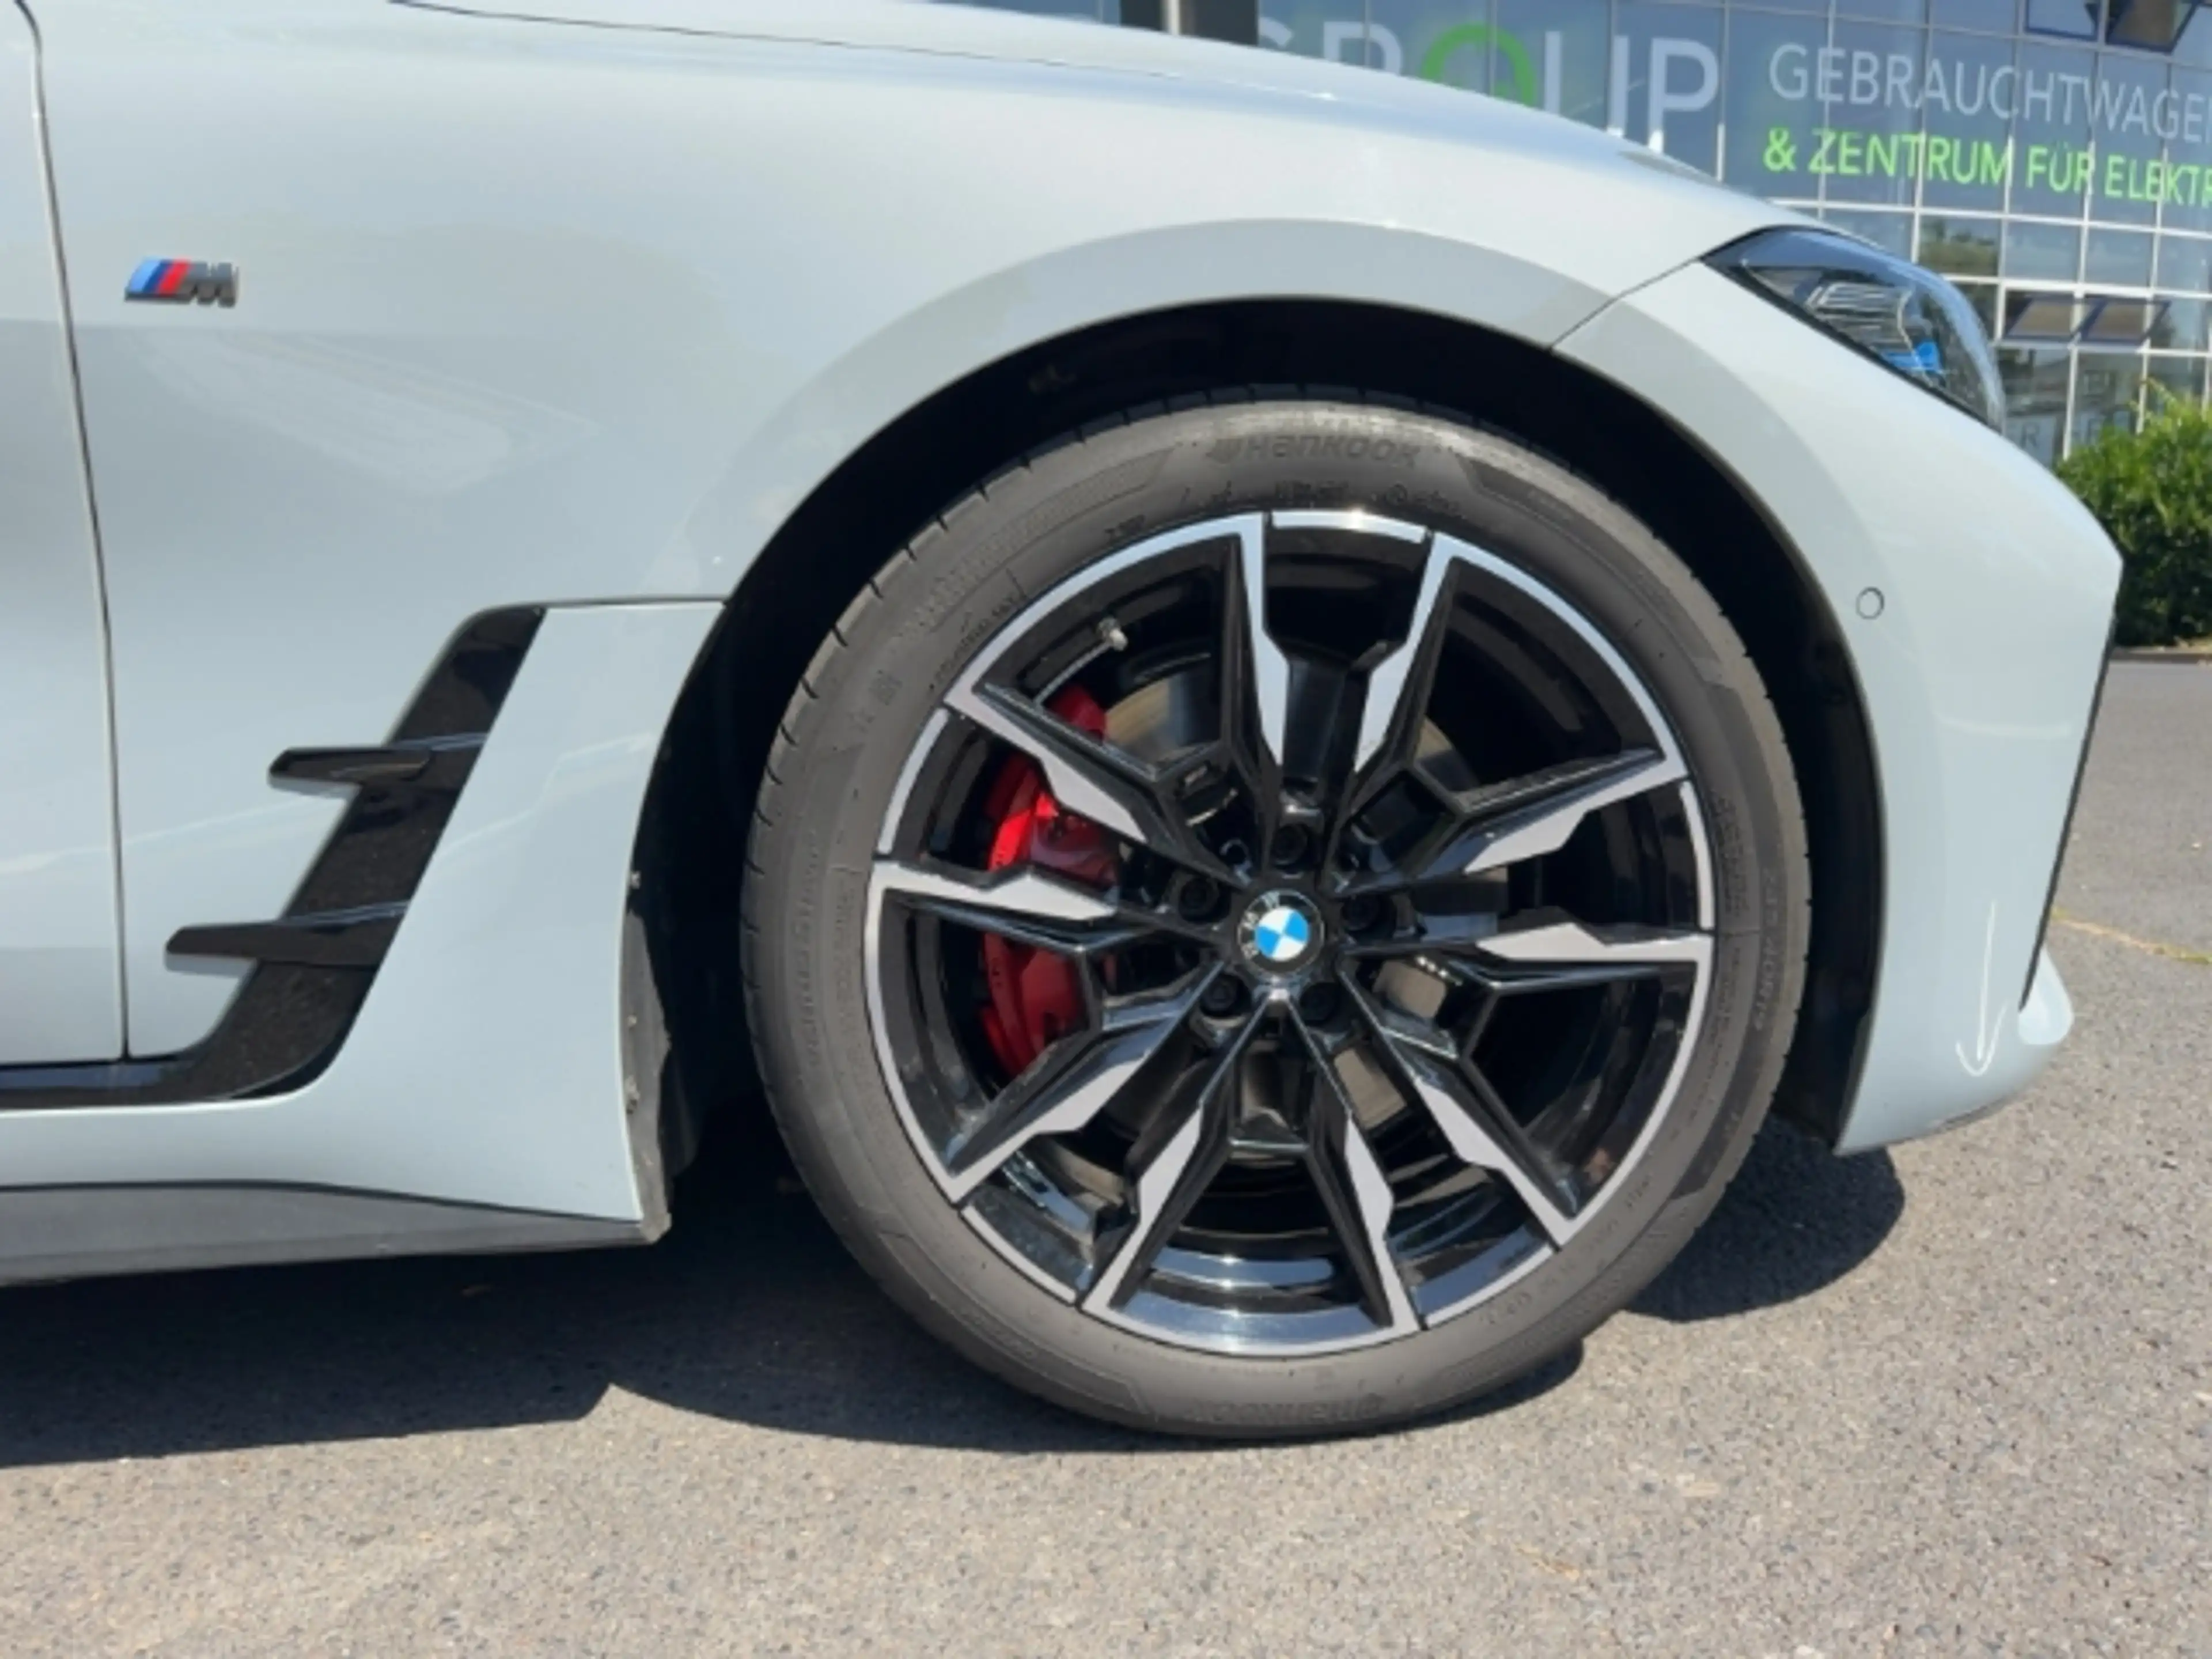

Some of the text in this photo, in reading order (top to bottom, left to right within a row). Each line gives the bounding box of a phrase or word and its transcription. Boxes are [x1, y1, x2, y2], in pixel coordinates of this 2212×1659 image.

[1258, 17, 1719, 153] OUP
[1769, 43, 2212, 144] GEBRAUCHTWAGE
[1763, 127, 1797, 172] &
[1808, 127, 2010, 188] ZENTRUM
[2026, 141, 2094, 194] FÜR
[173, 258, 240, 309] M
